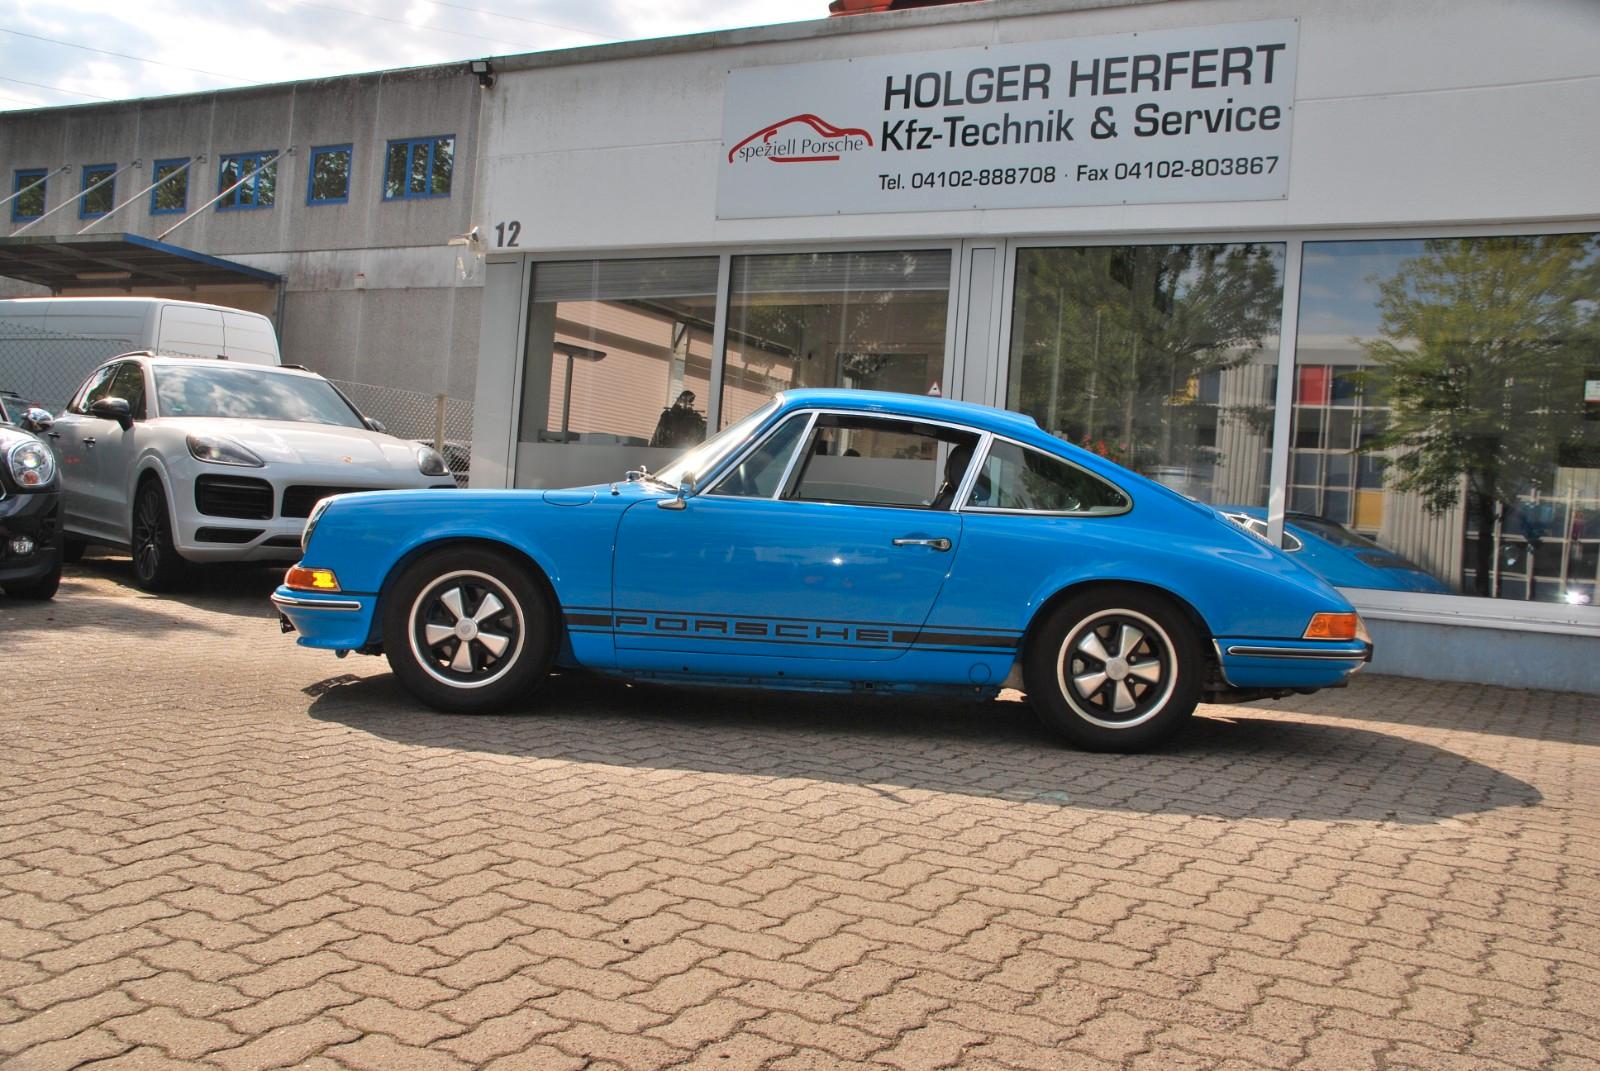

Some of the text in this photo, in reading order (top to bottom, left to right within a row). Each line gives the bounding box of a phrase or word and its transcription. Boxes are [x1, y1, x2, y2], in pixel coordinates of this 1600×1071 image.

[884, 43, 1286, 111] HOLGER HERFERT
[881, 98, 1281, 151] Kfz-Technik & Service
[739, 135, 864, 162] speziell Porsche
[878, 156, 1280, 190] Tel. 04102-888708 Fax 04102-803867
[495, 220, 521, 248] 12
[615, 615, 889, 643] PORSCHE
